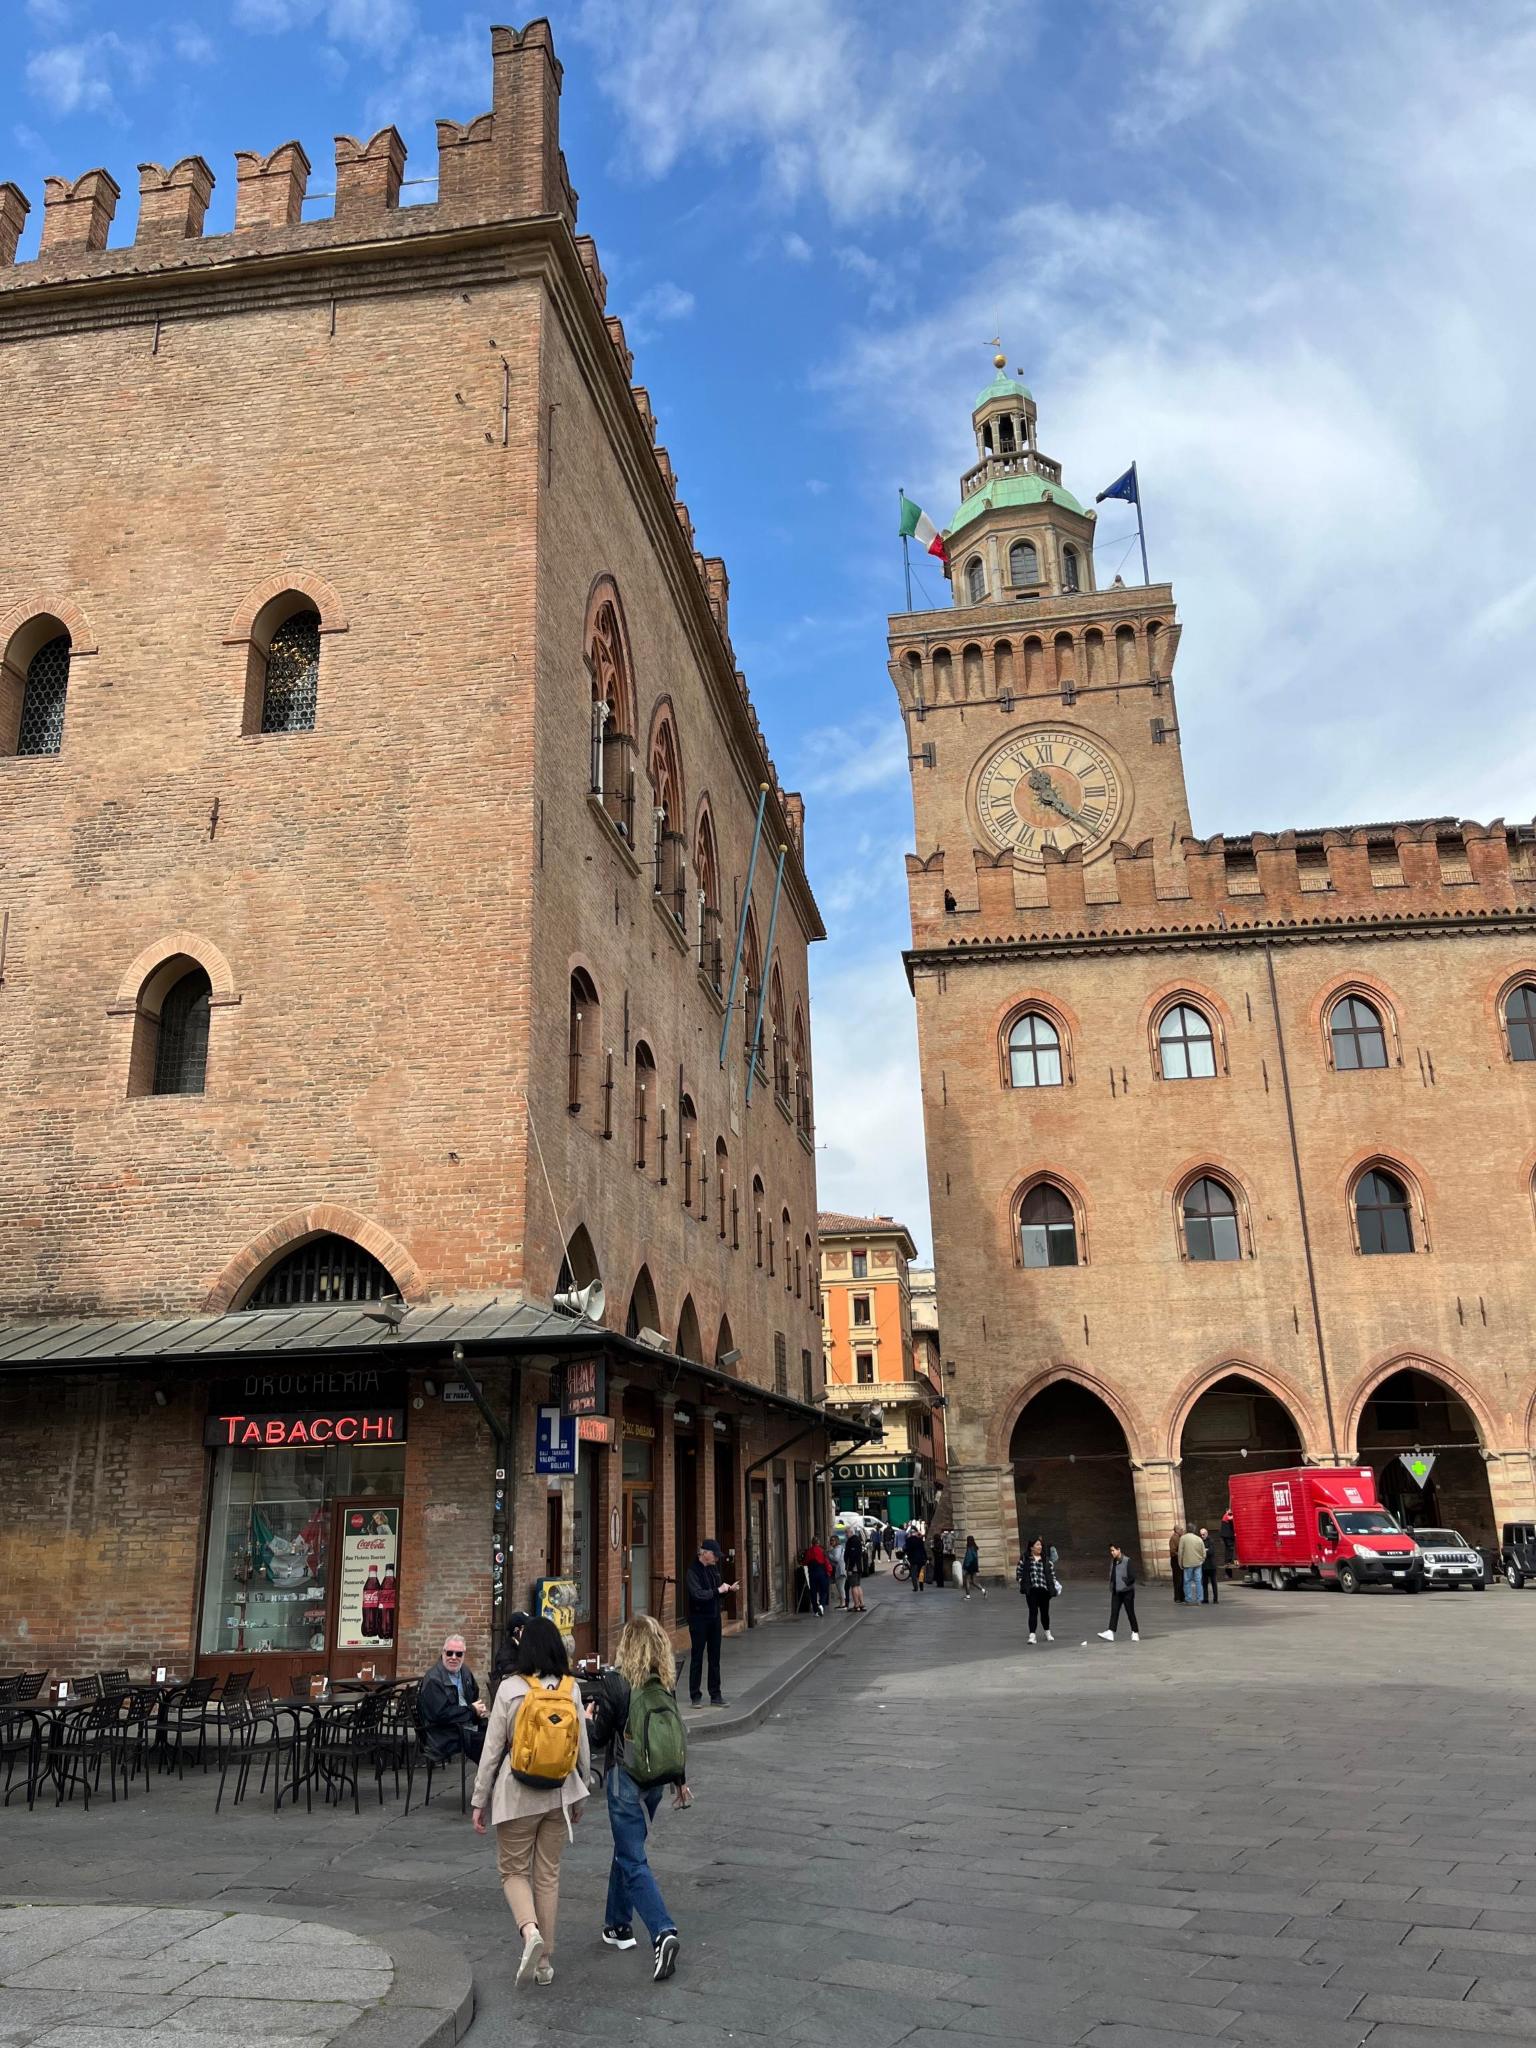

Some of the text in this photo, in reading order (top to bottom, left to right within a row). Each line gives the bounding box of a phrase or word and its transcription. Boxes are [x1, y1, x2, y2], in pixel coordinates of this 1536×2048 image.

[1034, 744, 1054, 764] XII
[1062, 748, 1074, 766] I
[994, 771, 1016, 787] X
[1076, 763, 1098, 779] II
[1084, 785, 1106, 798] III
[218, 1416, 394, 1445] TABACCHI
[1274, 1490, 1290, 1507] BRT
